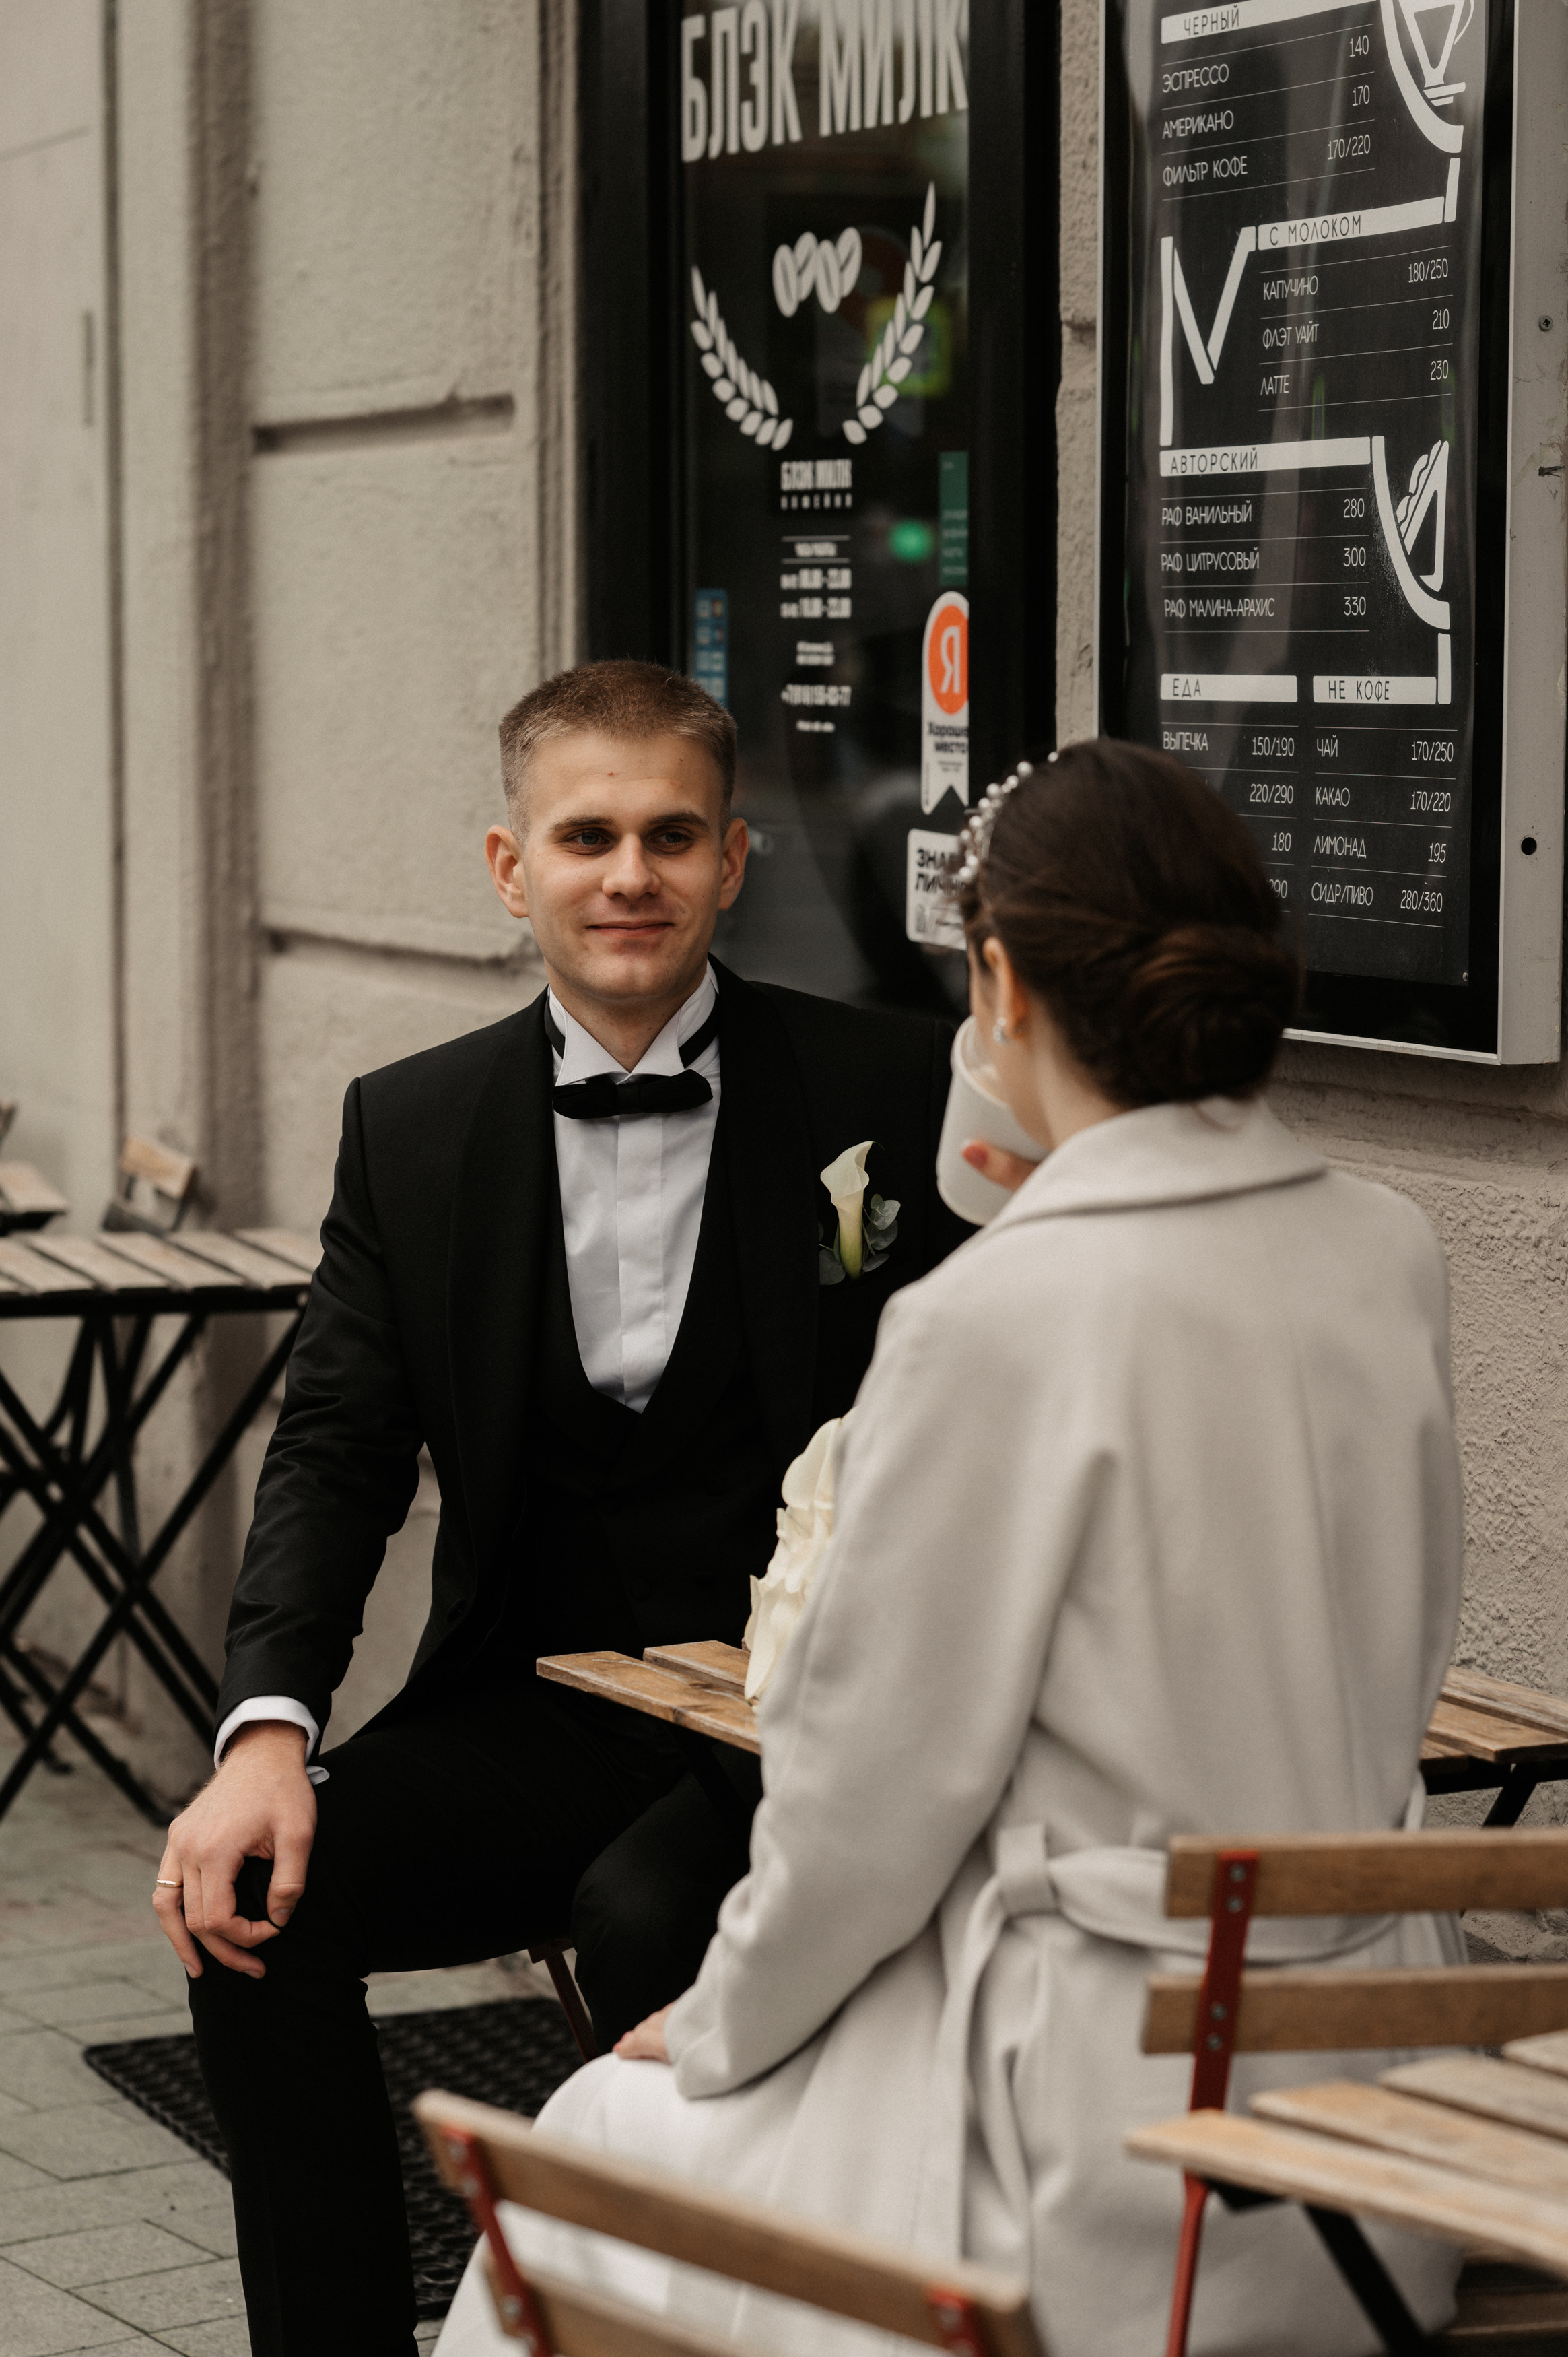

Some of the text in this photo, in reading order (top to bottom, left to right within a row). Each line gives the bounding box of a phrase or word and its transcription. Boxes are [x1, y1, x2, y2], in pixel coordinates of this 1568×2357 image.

[1184, 5, 1239, 35] ЧЕРНЫЙ
[1162, 35, 1369, 93] ЭСПРЕССО 140
[681, 0, 968, 162] БЛЭК МИЛК
[1163, 85, 1369, 139] АМЕРИКАНО 170
[1163, 135, 1370, 187] ФИЛЬТР КОФЕ 170/220
[1270, 215, 1360, 246] С МОЛОКОМ
[1264, 258, 1448, 300] КАПУЧИНО 180/250
[1263, 309, 1449, 349] ФЛЭТ УАЙТ 210
[1260, 360, 1448, 395] ЛАТТЕ 230
[1170, 448, 1257, 474] АВТОРСКИЙ
[1162, 498, 1364, 526] РАФ ВАНИЛЬНЫЙ 280
[1161, 547, 1365, 572] РАФ ЦИТРУСОВЫЙ 300
[1164, 597, 1366, 618] РАФ МАЛИНА-АРАХИС 330
[941, 625, 961, 694] Я
[1173, 678, 1200, 697] ЕДА
[1329, 679, 1389, 701] НЕ КОФЕ
[1163, 731, 1294, 756] ВЫПЕЧКА 150/190
[1317, 735, 1453, 762] ЧАЙ 170/250
[1250, 784, 1293, 803] 220/290
[1316, 787, 1450, 811] КАКАО 170/220
[1272, 832, 1291, 851] 180
[1314, 836, 1446, 863] ЛИМОНАД 195
[1311, 882, 1442, 912] СИДР/ПИВО 280/360
